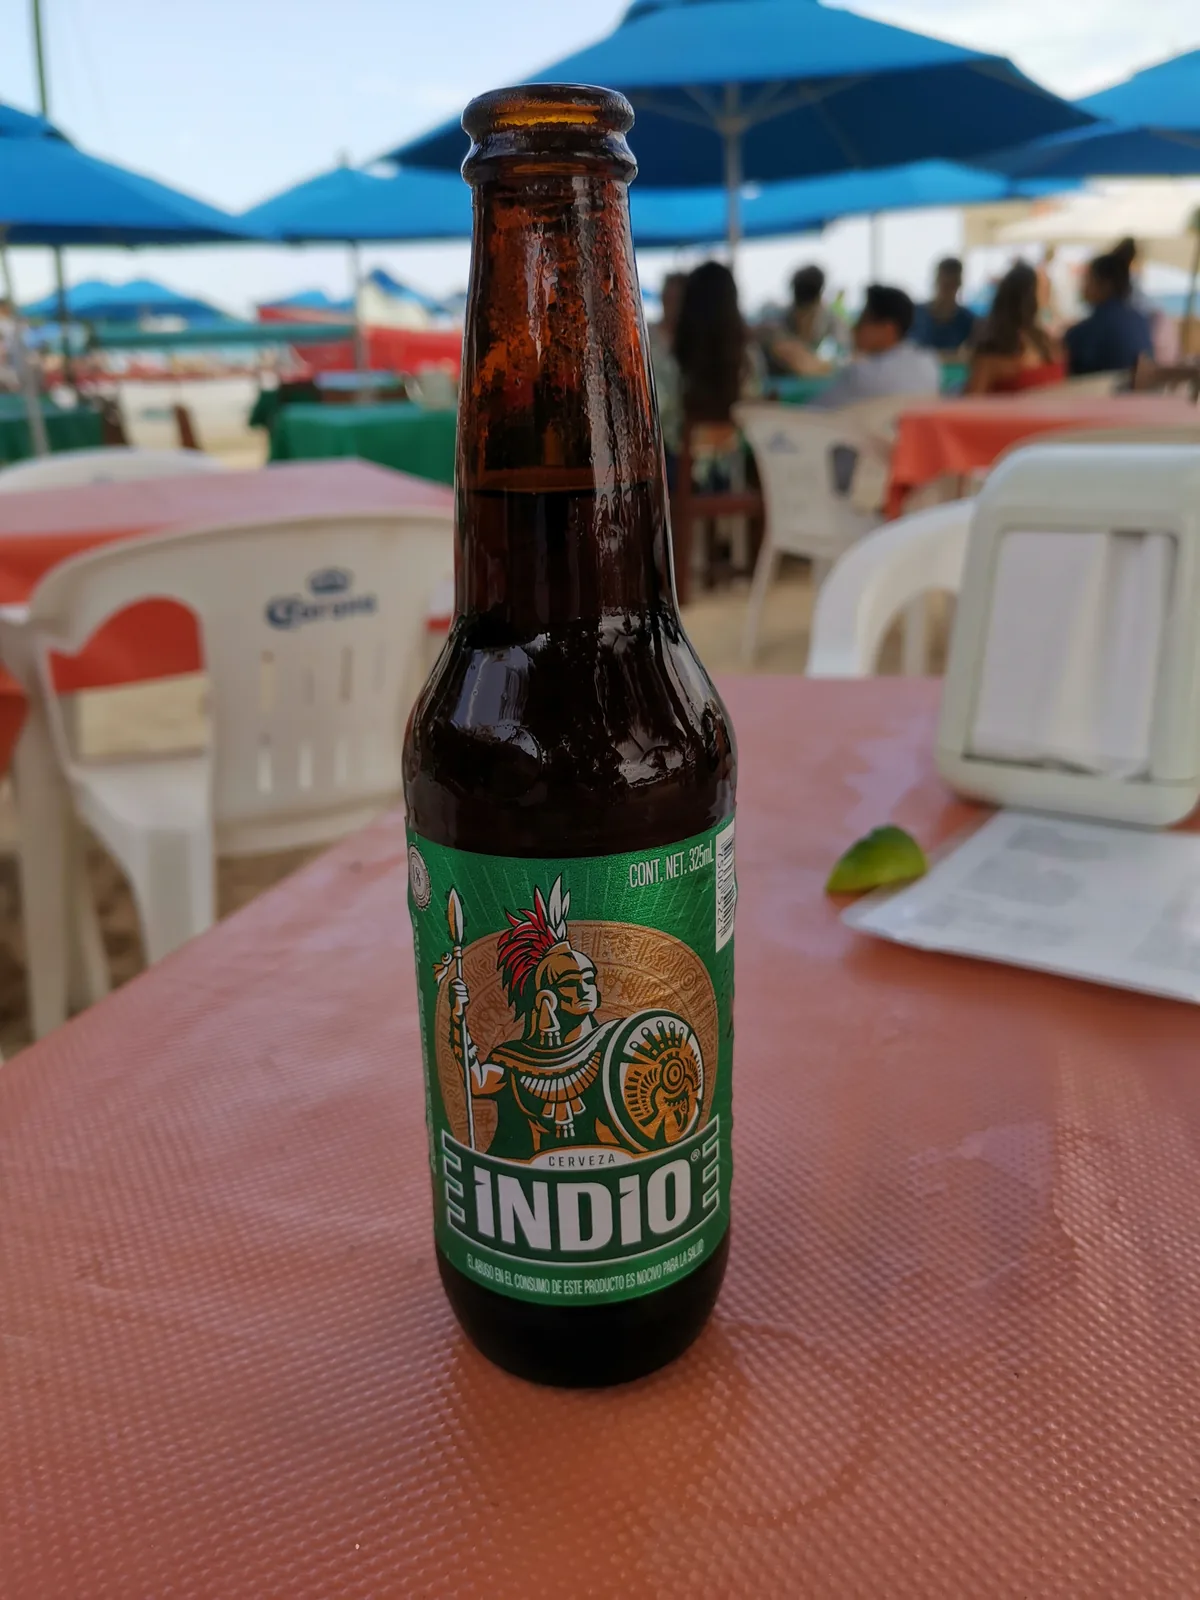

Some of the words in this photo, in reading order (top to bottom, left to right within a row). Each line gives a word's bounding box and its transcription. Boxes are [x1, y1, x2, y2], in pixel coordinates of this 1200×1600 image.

[629, 859, 664, 888] CONT.
[666, 851, 688, 880] NET.
[689, 839, 715, 872] 325mL
[548, 1152, 616, 1168] CERVEZA
[473, 1158, 692, 1252] INDIO
[514, 1273, 550, 1294] CONSUMO
[552, 1279, 562, 1294] DE
[563, 1279, 583, 1295] ESTE
[584, 1275, 625, 1295] PRODUCTO
[625, 1272, 636, 1288] ES
[679, 1250, 688, 1268] LA
